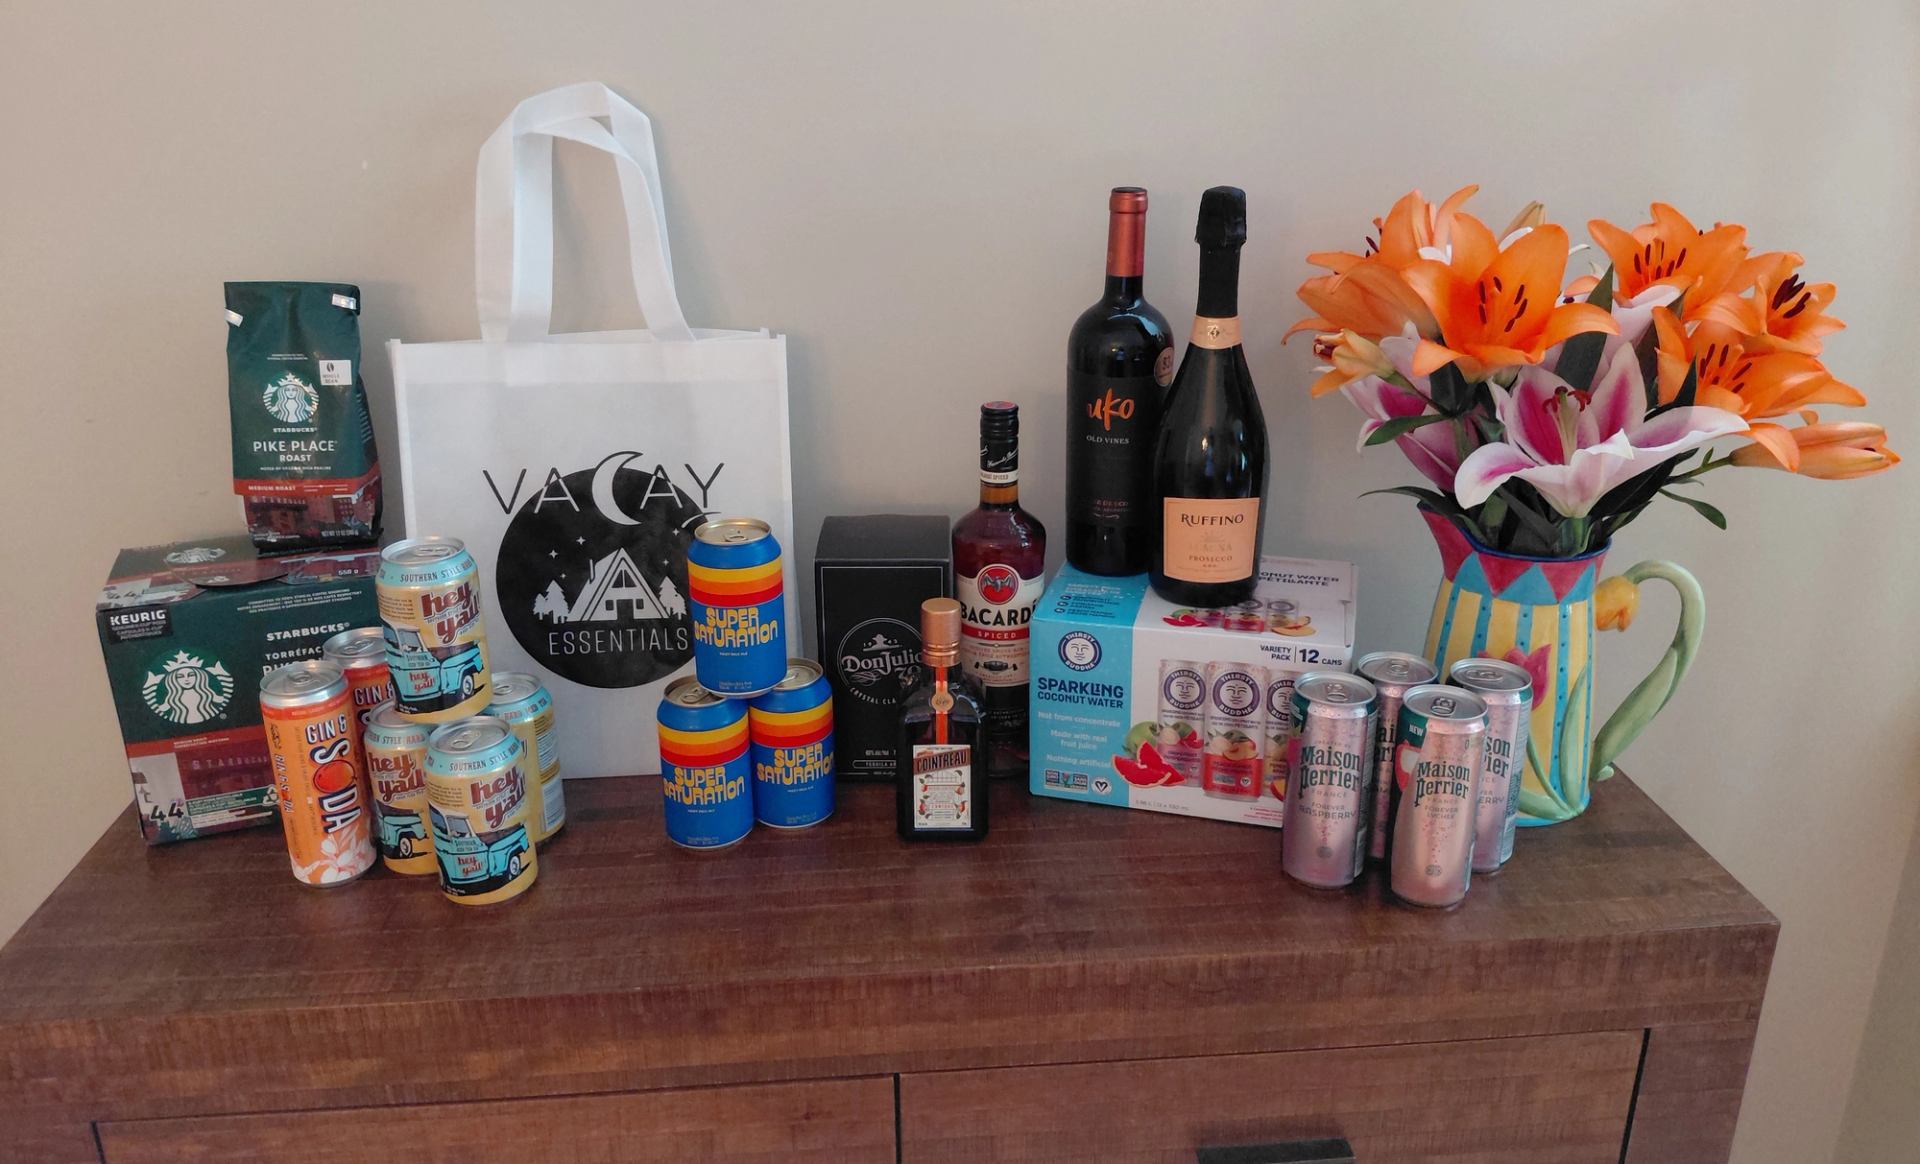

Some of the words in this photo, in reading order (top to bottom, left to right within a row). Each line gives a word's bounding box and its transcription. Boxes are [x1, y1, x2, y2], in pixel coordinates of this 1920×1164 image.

[253, 441, 286, 452] PIKE
[291, 440, 335, 452] PLACE
[1086, 434, 1103, 443] OLD
[1104, 436, 1130, 445] VINES
[280, 454, 311, 462] ROAST
[1181, 512, 1245, 527] RUFFINO
[1188, 554, 1233, 563] PROSECCO
[400, 571, 438, 583] SOUTHERN
[440, 565, 462, 579] STYLE
[1296, 574, 1339, 583] WATER
[421, 581, 472, 618] hey
[110, 609, 167, 626] KEURIG
[706, 606, 760, 630] SUPER
[549, 627, 689, 656] ESSENTIALS
[694, 620, 778, 648] SATURATION
[977, 630, 1017, 639] SPICED
[1260, 644, 1292, 653] VARIETY
[1271, 653, 1291, 661] PACK
[1299, 648, 1320, 664] 12
[1321, 658, 1343, 666] CANS
[354, 685, 383, 705] GIN
[1037, 676, 1124, 700] SPARKLING
[1037, 690, 1086, 705] COCONUT
[1087, 696, 1124, 709] WATER
[306, 720, 336, 744] GIN
[338, 713, 348, 733] &
[1409, 723, 1425, 737] NEW
[774, 742, 823, 768] SUPER
[916, 751, 968, 771] COINTREAU
[1301, 745, 1361, 771] Maison
[367, 751, 414, 779] hey
[449, 760, 488, 772] SOUTHERN
[1416, 760, 1470, 782] Maison
[470, 766, 520, 806] hey
[674, 766, 726, 787] SUPER
